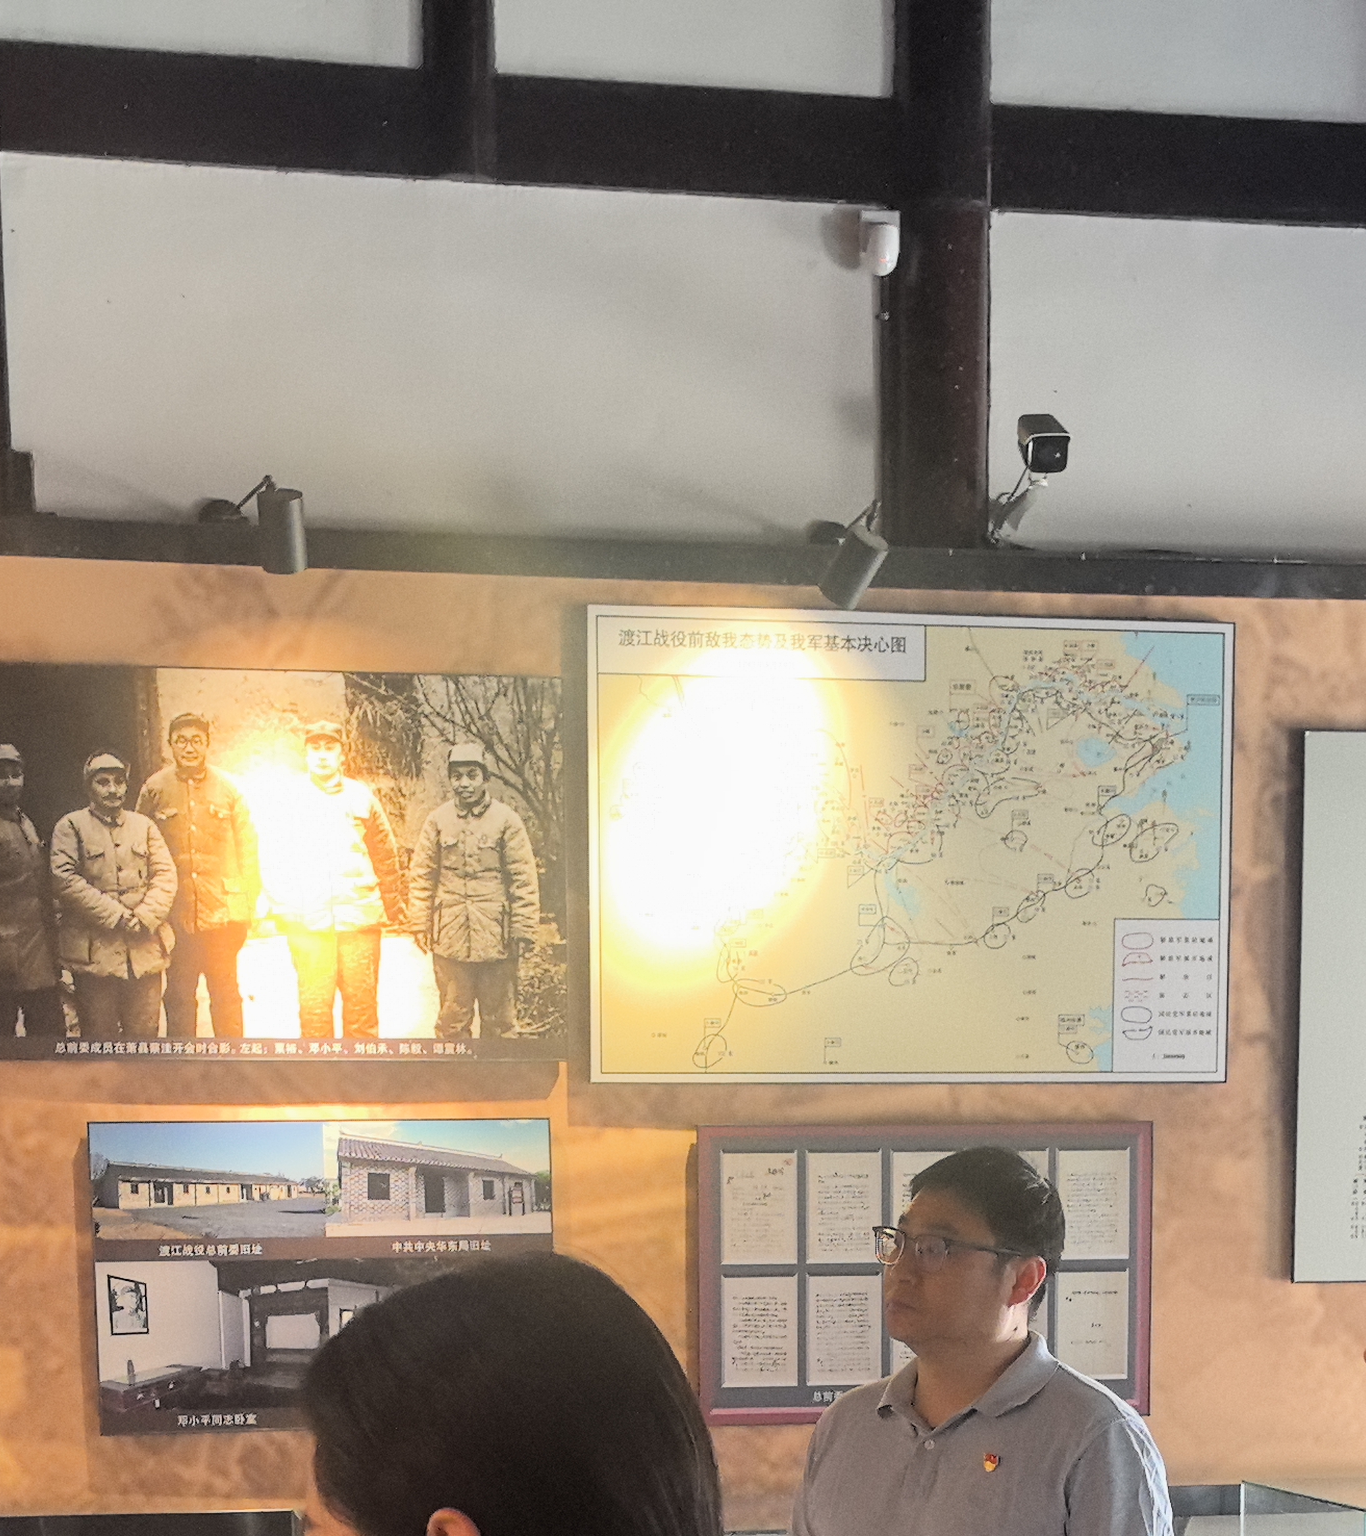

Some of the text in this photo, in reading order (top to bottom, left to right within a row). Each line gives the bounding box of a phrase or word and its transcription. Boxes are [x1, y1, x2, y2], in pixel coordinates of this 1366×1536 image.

[618, 628, 907, 655] 渡江战役前敌我态势及我军基本决心图
[158, 1242, 264, 1258] 渡江战役总前委旧址
[391, 1239, 493, 1255] 中共中央华东局旧址
